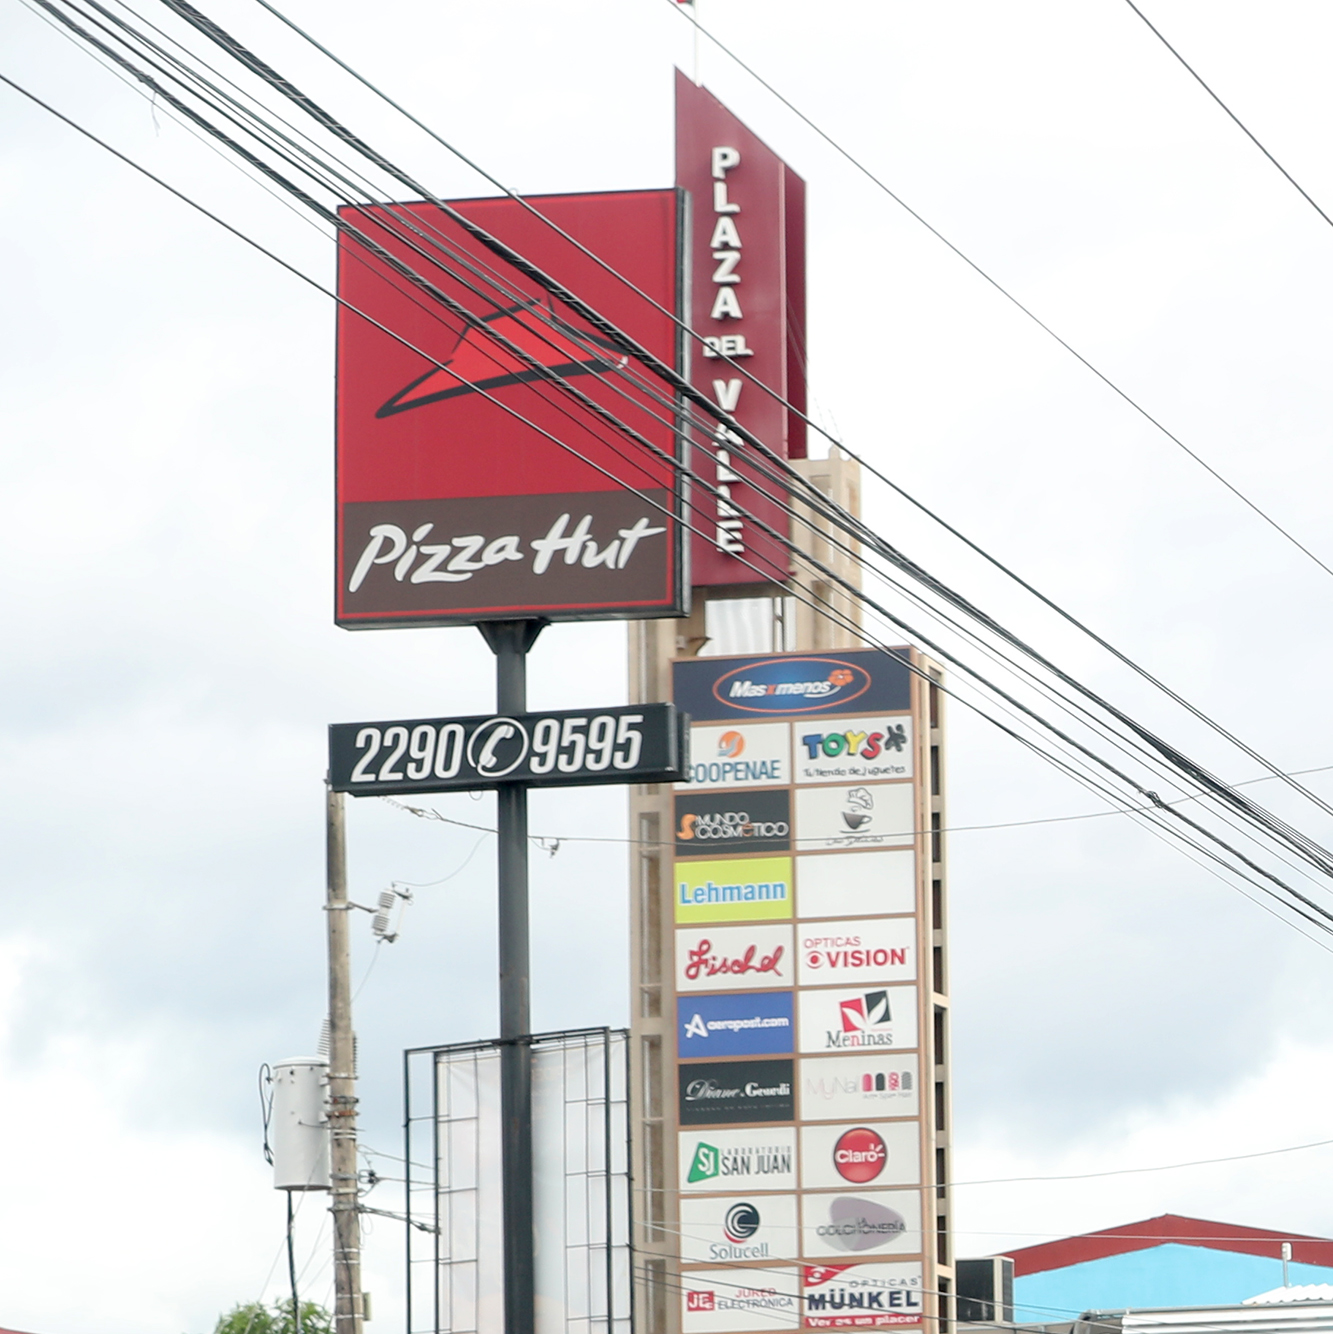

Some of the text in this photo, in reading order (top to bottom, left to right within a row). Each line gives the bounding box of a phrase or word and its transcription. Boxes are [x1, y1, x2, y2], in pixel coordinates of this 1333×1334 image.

[711, 146, 744, 322] PLAZA
[703, 334, 755, 360] DEL
[348, 511, 667, 593] Pizza Hut
[350, 714, 645, 784] 2290 9595
[688, 759, 782, 783] OOPENAE
[695, 811, 750, 826] MUNDO
[679, 882, 787, 905] Lehmann
[827, 948, 907, 968] VISION
[826, 1030, 893, 1048] Meninas
[721, 1154, 792, 1176] SAN JUAN
[835, 1149, 879, 1164] Claro
[710, 1243, 769, 1261] Solucell
[807, 1288, 920, 1311] MÜNKEL
[808, 1317, 831, 1327] Ver
[875, 1314, 920, 1326] placer
